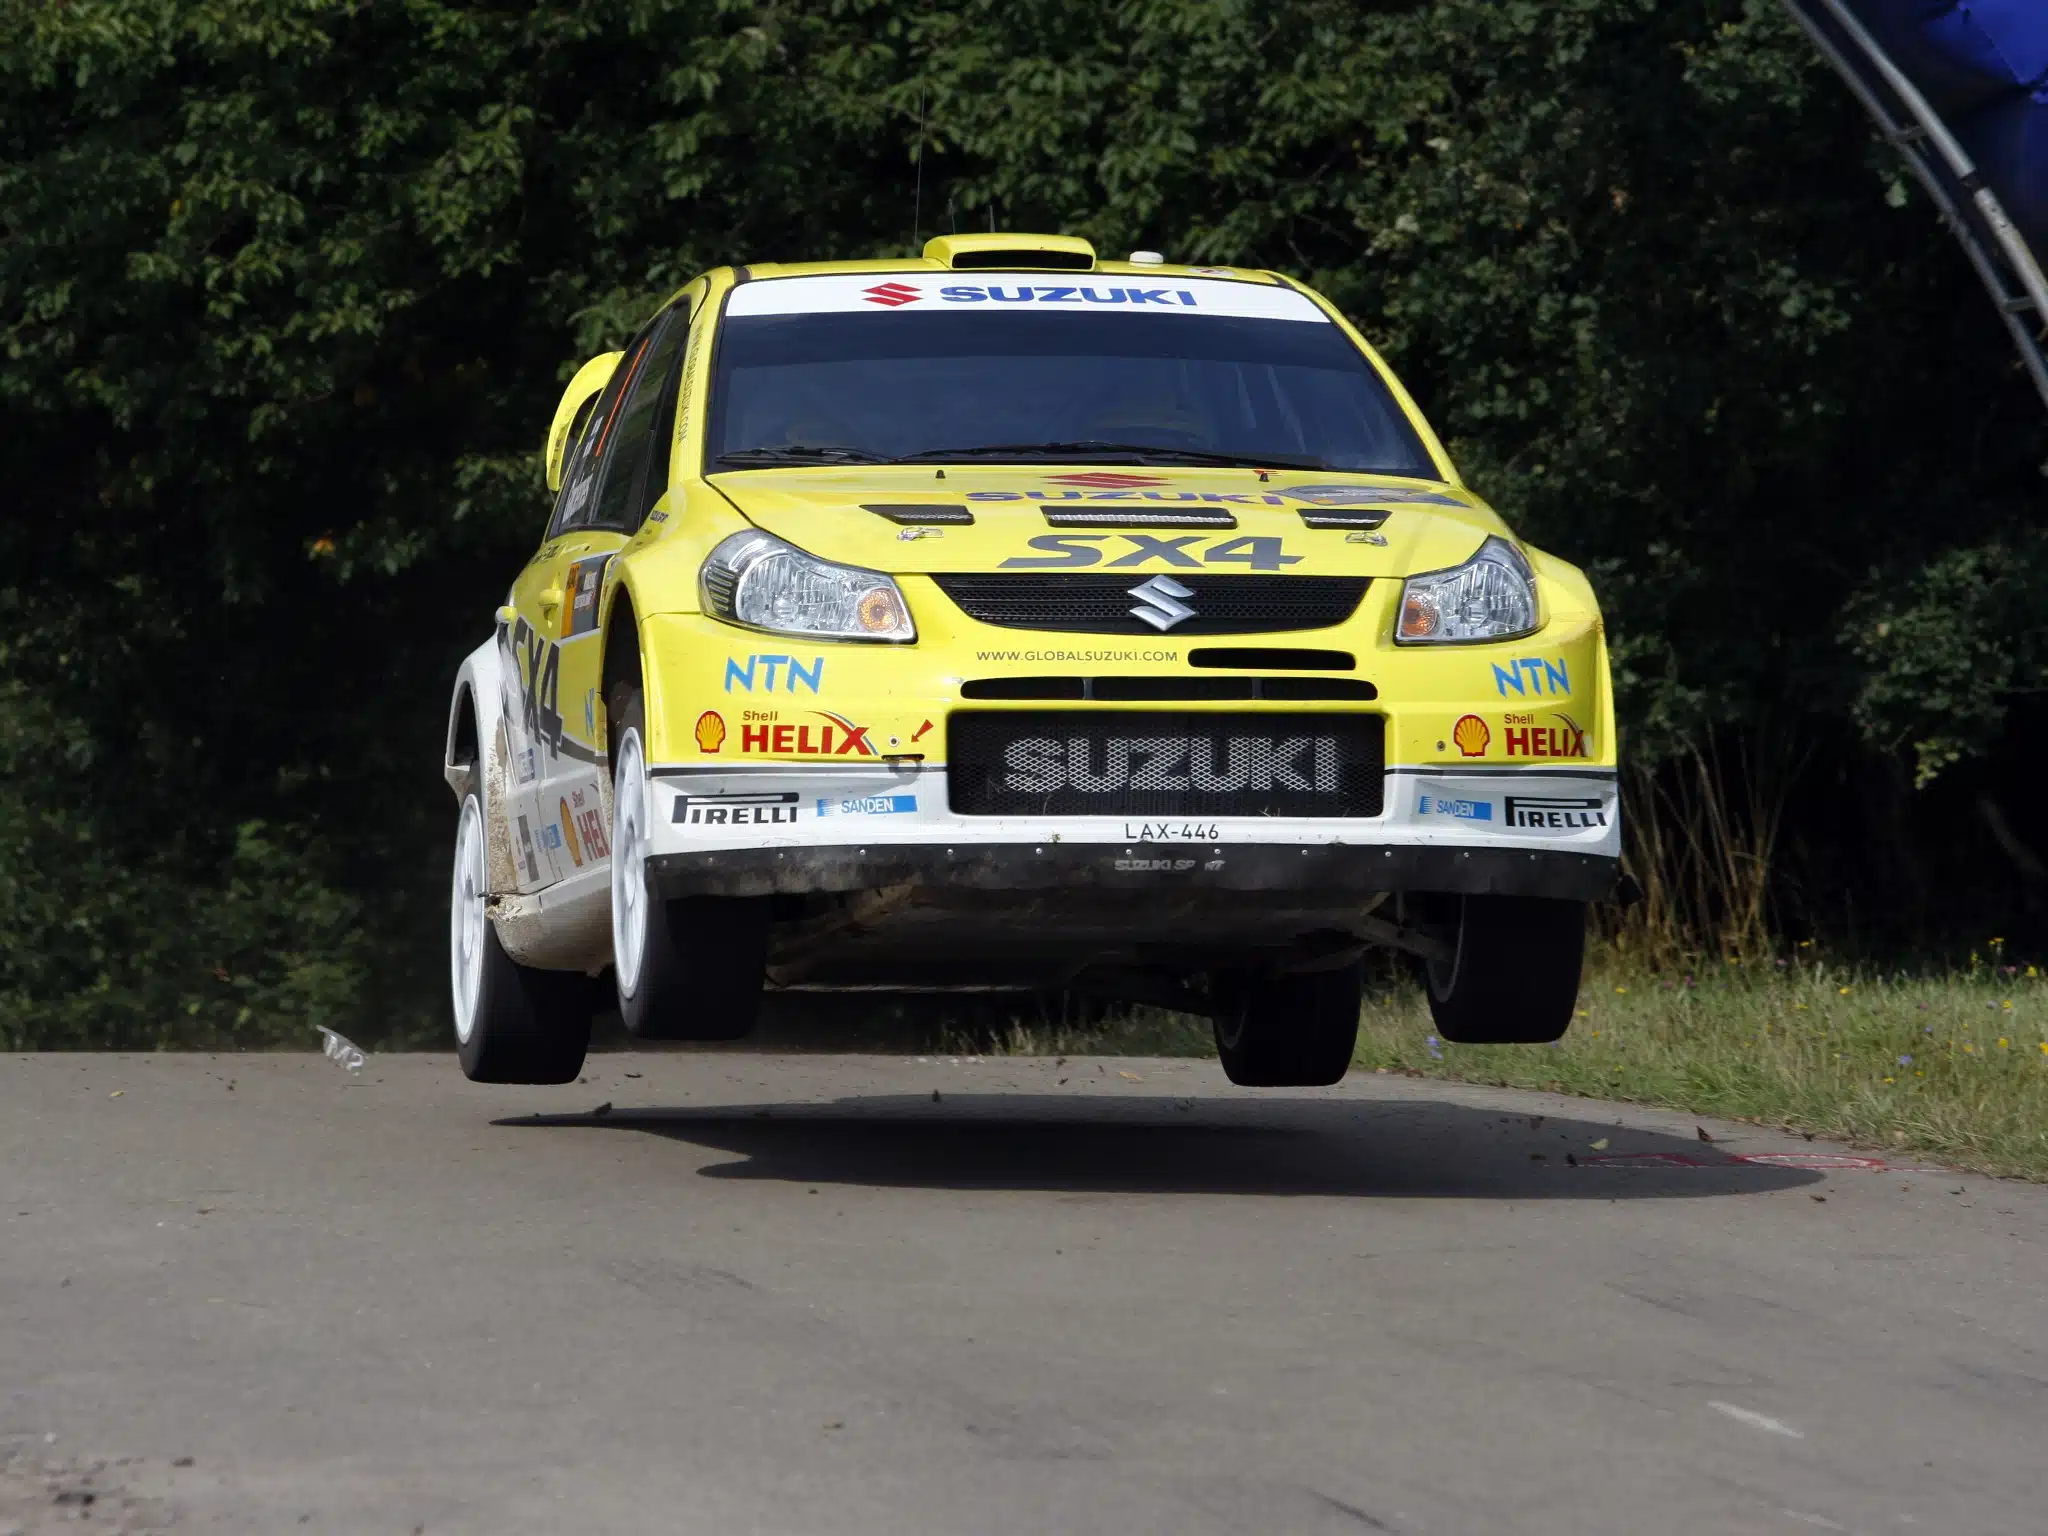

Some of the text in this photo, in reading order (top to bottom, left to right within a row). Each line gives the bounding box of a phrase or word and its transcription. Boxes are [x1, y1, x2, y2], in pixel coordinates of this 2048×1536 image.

[941, 286, 1198, 306] SUZUKI
[964, 491, 1286, 507] SUZUKI
[997, 534, 1305, 571] SX4
[976, 651, 1180, 663] WWW.GLOBALSUZUKI.COM
[724, 655, 824, 695] NTN
[1491, 658, 1572, 698] NTN
[742, 710, 779, 722] Shell
[1503, 713, 1535, 725] Shell
[742, 722, 872, 756] HELIX
[1504, 726, 1588, 758] HELIX
[1003, 736, 1341, 793] SUZUKI
[671, 792, 801, 825] PIRELLI
[841, 797, 895, 815] SANDEN
[1436, 800, 1475, 817] SANDEN
[1504, 796, 1609, 828] PIRELLI
[1124, 823, 1221, 840] LAX-446
[1114, 859, 1172, 871] SUZUKI
